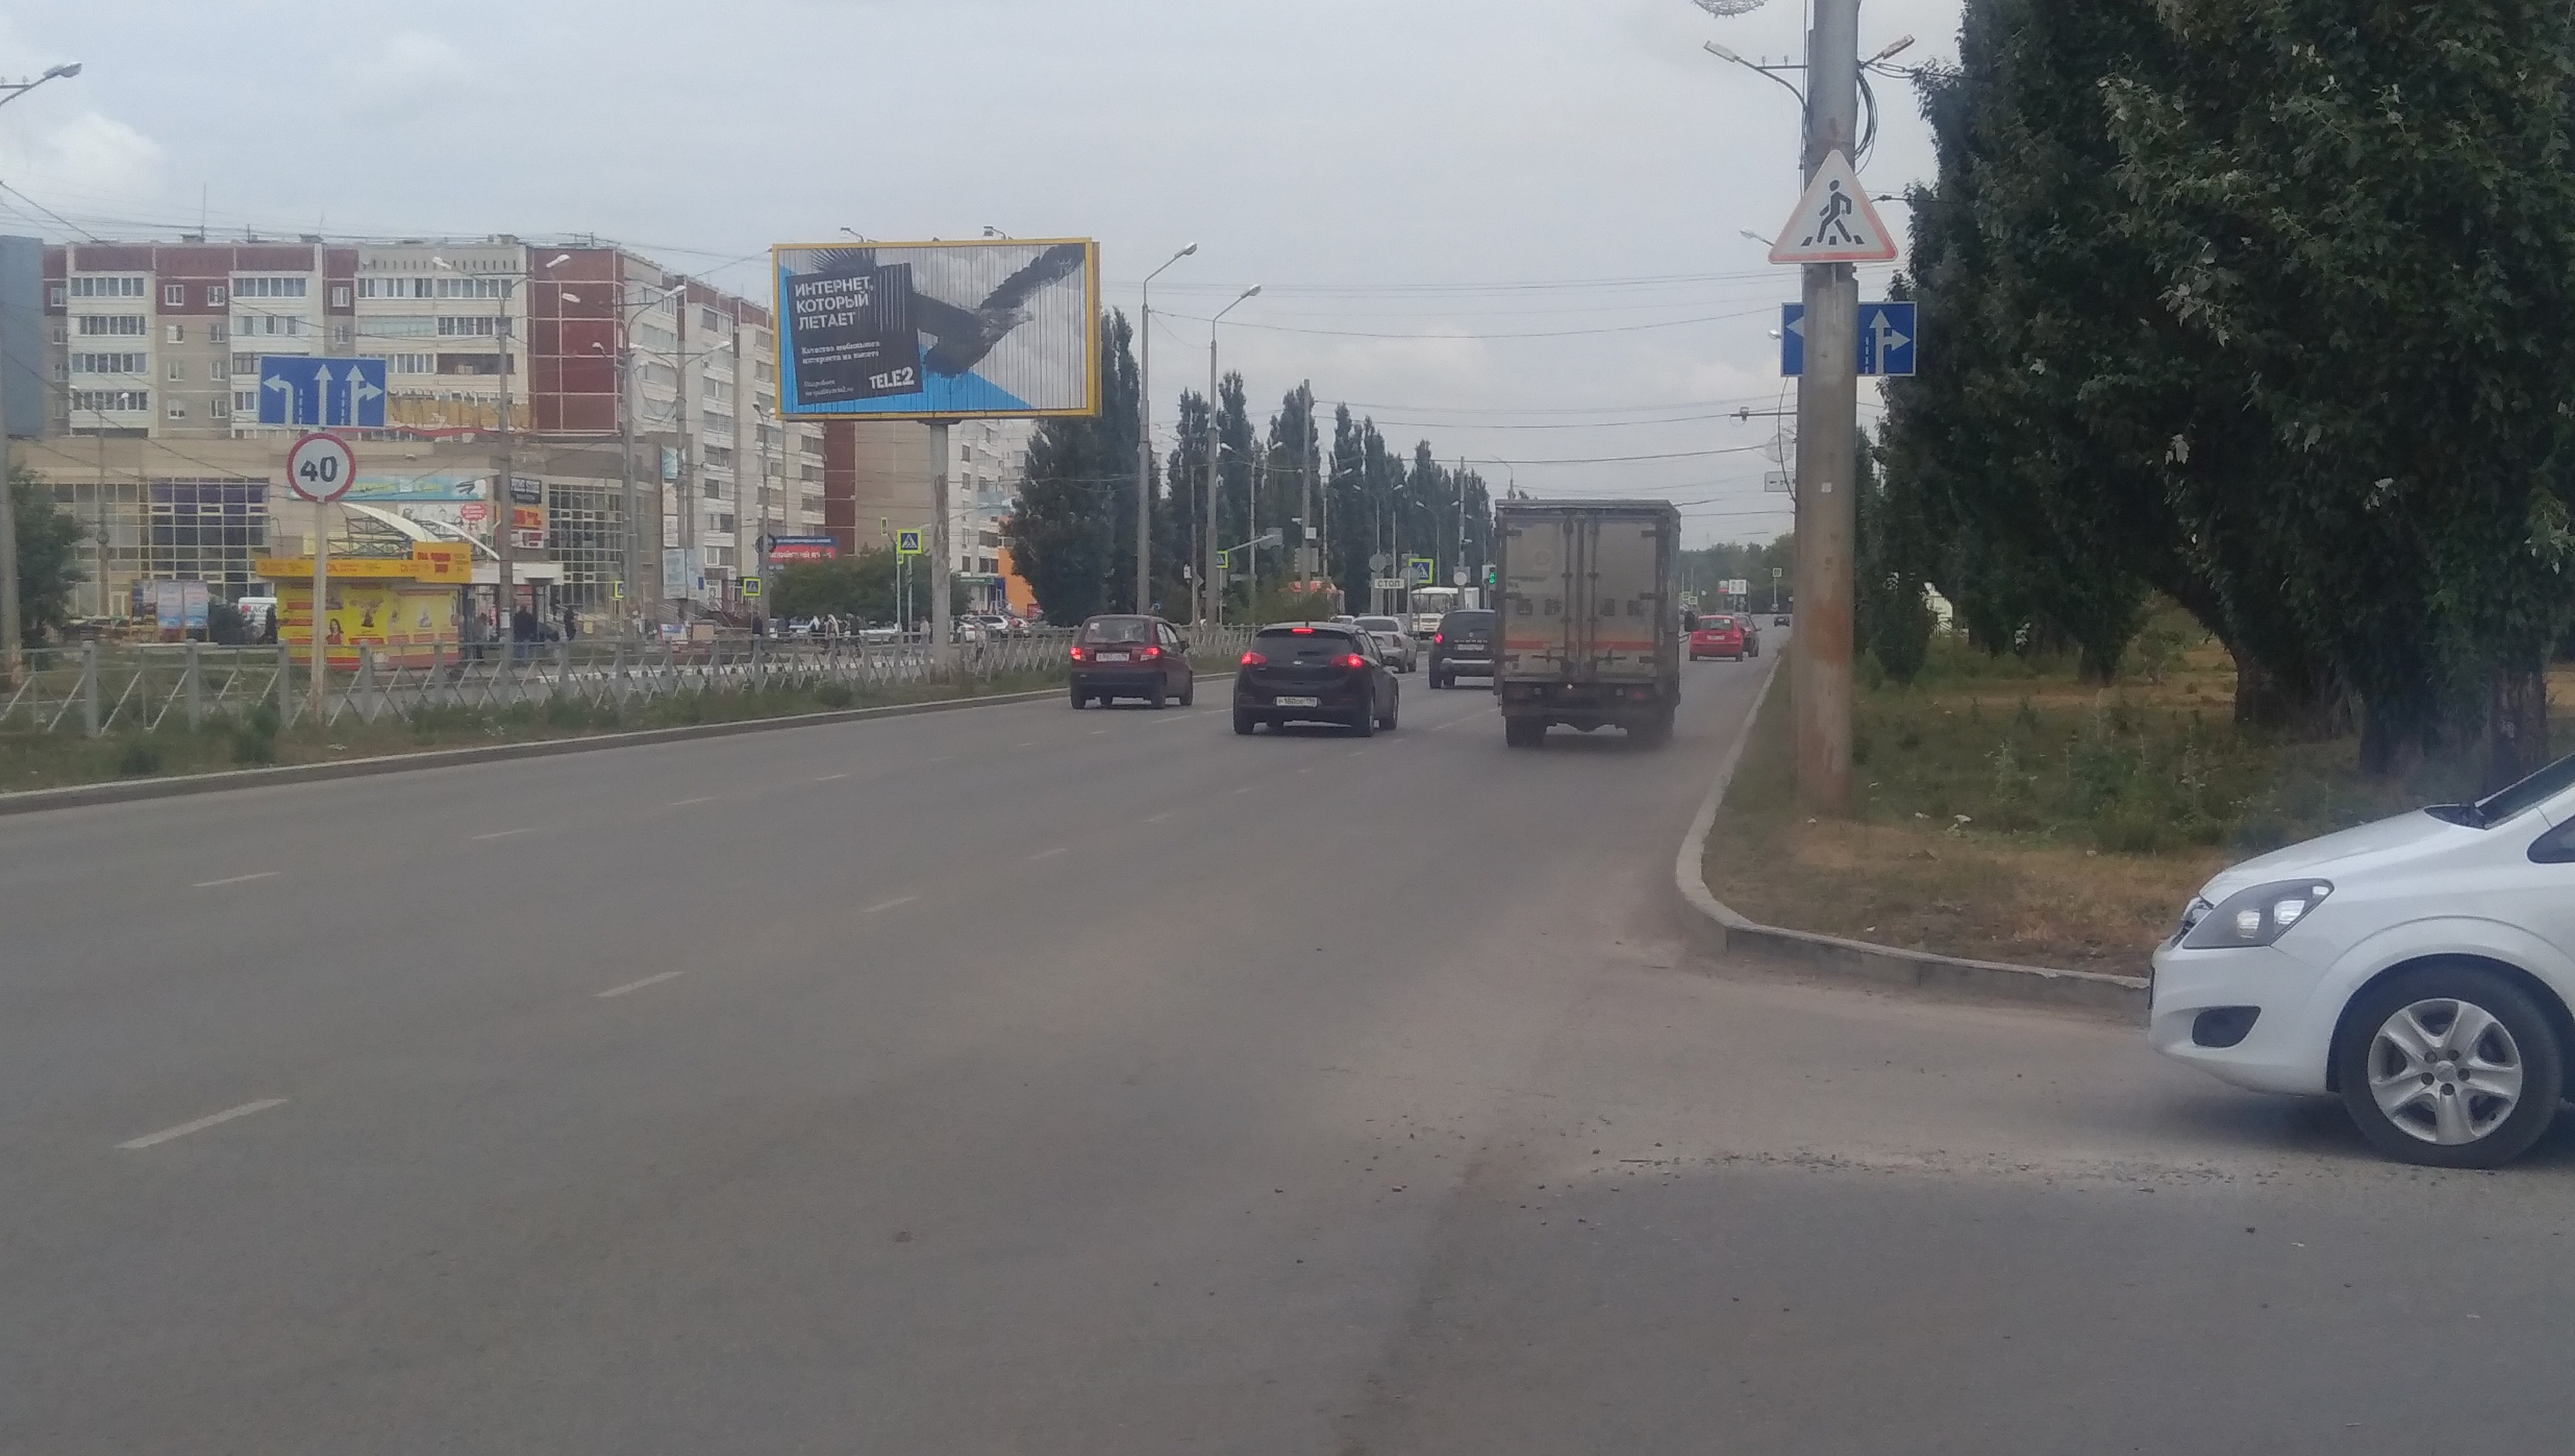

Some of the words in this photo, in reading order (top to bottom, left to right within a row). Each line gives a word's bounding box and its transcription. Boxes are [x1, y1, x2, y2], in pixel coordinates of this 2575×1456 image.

[795, 275, 874, 297] ИНТЕРНЕТ,
[796, 291, 870, 313] КОТОРЫЙ
[798, 312, 856, 331] ЛЕТАЕТ
[868, 366, 915, 390] TELE2
[300, 456, 338, 482] 40
[1377, 579, 1400, 588] СТОП
